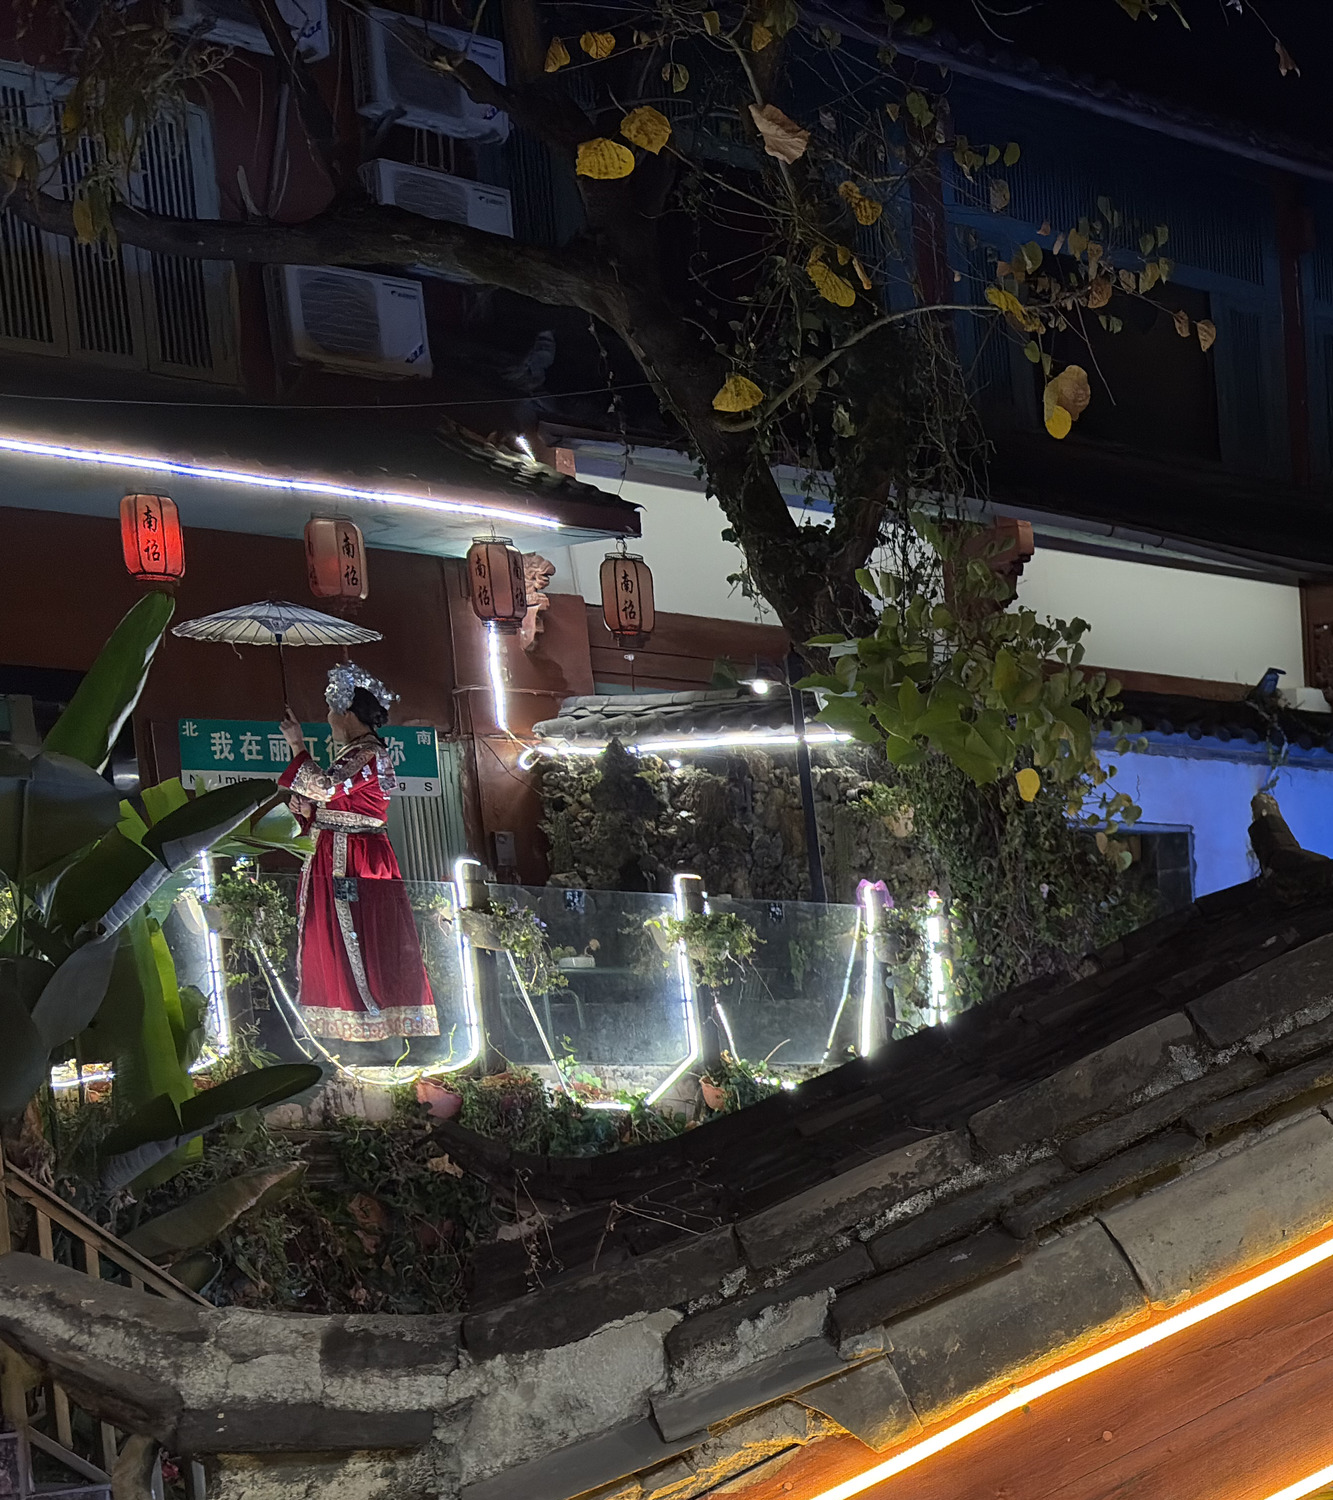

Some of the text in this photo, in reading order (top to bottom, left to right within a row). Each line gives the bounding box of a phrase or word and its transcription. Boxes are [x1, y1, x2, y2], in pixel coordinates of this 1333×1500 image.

[182, 722, 198, 737] 北
[416, 730, 432, 746] 南
[425, 783, 433, 791] S
